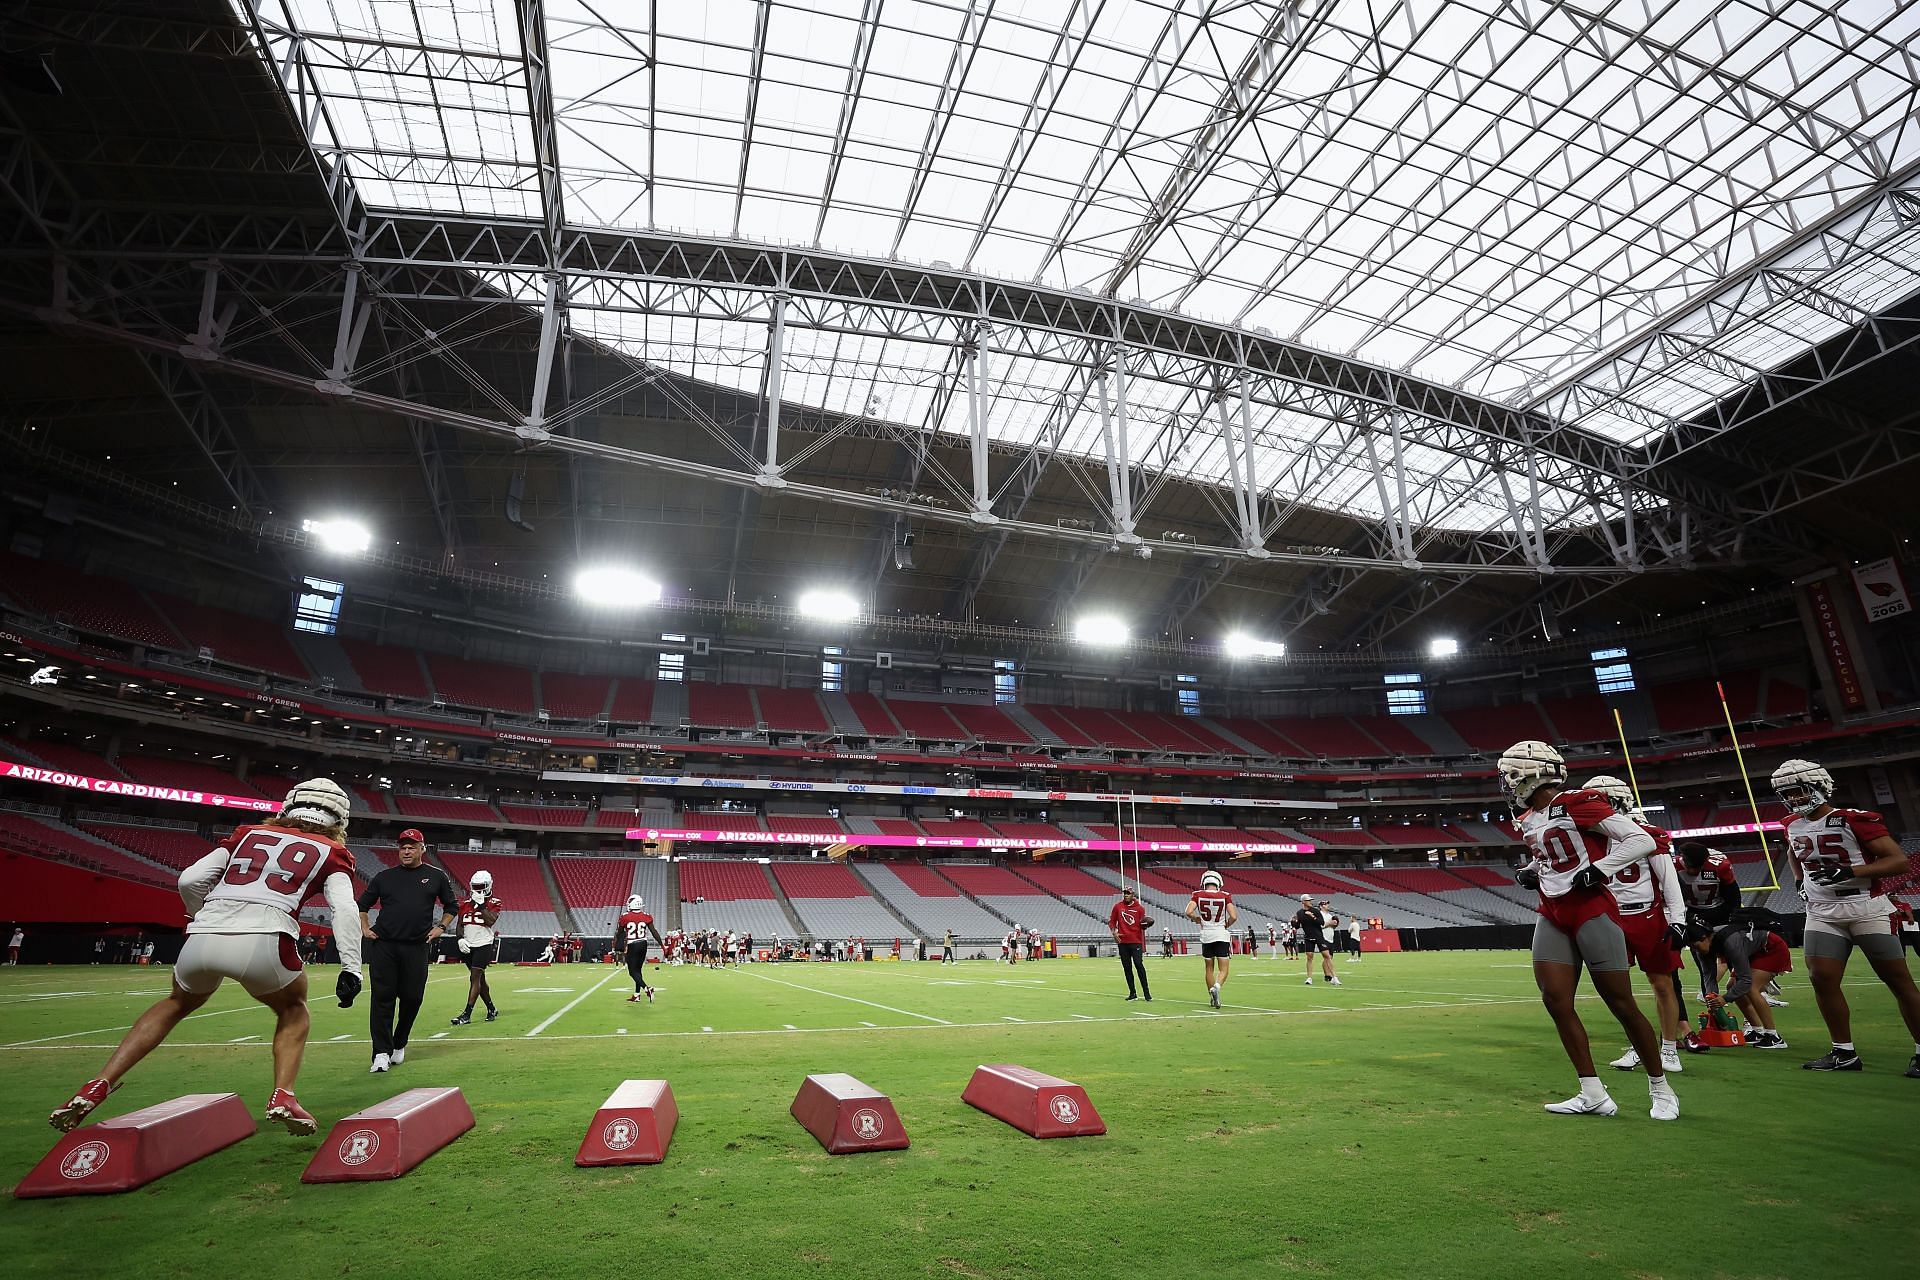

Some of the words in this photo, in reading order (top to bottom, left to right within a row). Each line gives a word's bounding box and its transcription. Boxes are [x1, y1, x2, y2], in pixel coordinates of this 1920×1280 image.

[1872, 603, 1905, 618] 2008
[1817, 594, 1846, 666] FOOTBALL
[1840, 667, 1858, 704] CLUB
[257, 694, 274, 702] ROY
[275, 698, 300, 708] GREEN
[499, 732, 526, 740] CARSON
[527, 736, 552, 744] PALMER
[1682, 748, 1718, 758] MARSHALL
[6, 765, 90, 790] ARIZONA
[94, 780, 204, 803] CARDINALS
[252, 802, 272, 810] COX
[716, 831, 775, 841] ARIZONA
[777, 833, 847, 844] CARDINALS
[1670, 825, 1747, 839] CARDINALS
[976, 838, 1026, 847] ARIZONA
[1028, 840, 1088, 849] CARDINALS
[1201, 843, 1244, 851] ARIZONA
[1245, 844, 1298, 852] CARDINALS
[1793, 834, 1852, 866] 25
[223, 834, 321, 896] 59
[1200, 900, 1224, 922] 57
[627, 921, 646, 939] 26
[1731, 1033, 1739, 1045] G
[860, 1116, 876, 1132] R
[612, 1125, 629, 1142] R
[349, 1137, 369, 1156] R
[72, 1150, 98, 1169] R
[343, 1154, 368, 1164] ROGERS
[64, 1168, 94, 1176] ROGERS
